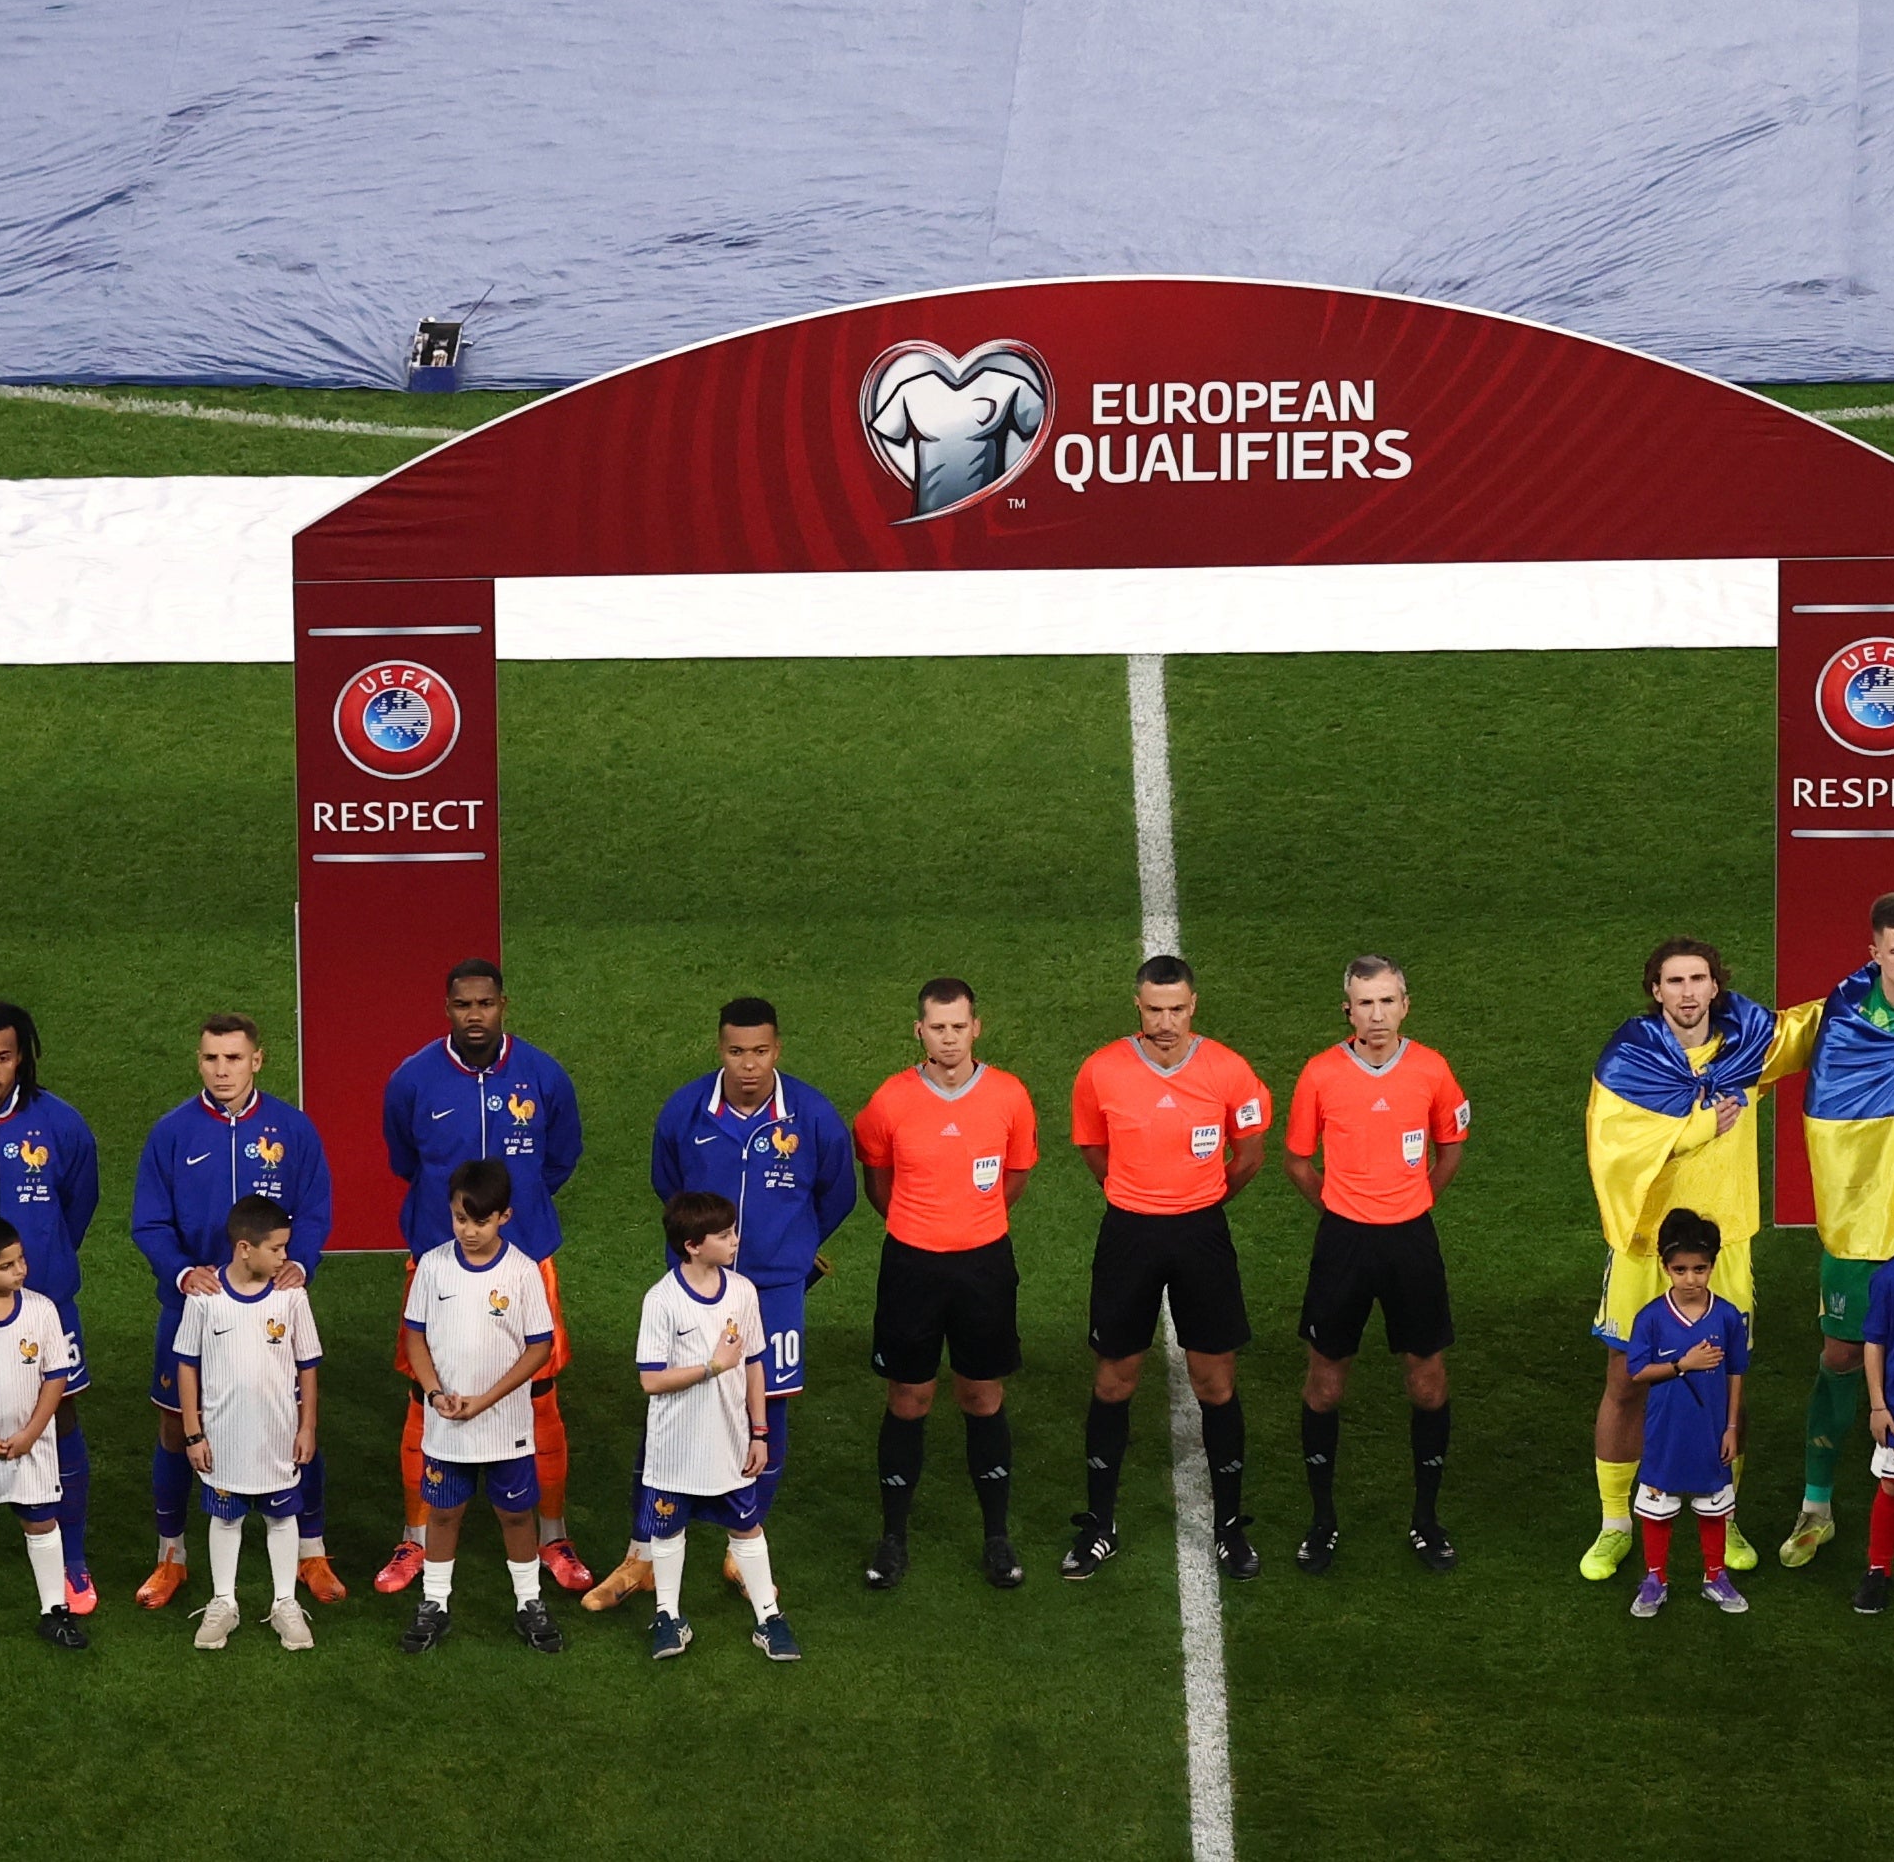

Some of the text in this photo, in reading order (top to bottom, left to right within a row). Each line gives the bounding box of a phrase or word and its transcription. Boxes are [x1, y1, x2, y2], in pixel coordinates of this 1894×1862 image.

[1092, 379, 1375, 425] EUROPEAN
[1053, 429, 1413, 493] QUALIFIERS
[1007, 499, 1026, 509] TM
[359, 669, 432, 695] UEFA
[313, 800, 484, 832] RESPECT
[1194, 1128, 1217, 1138] FIFA
[1404, 1132, 1423, 1144] FIFA
[976, 1159, 998, 1170] FIFA
[770, 1329, 800, 1369] 10
